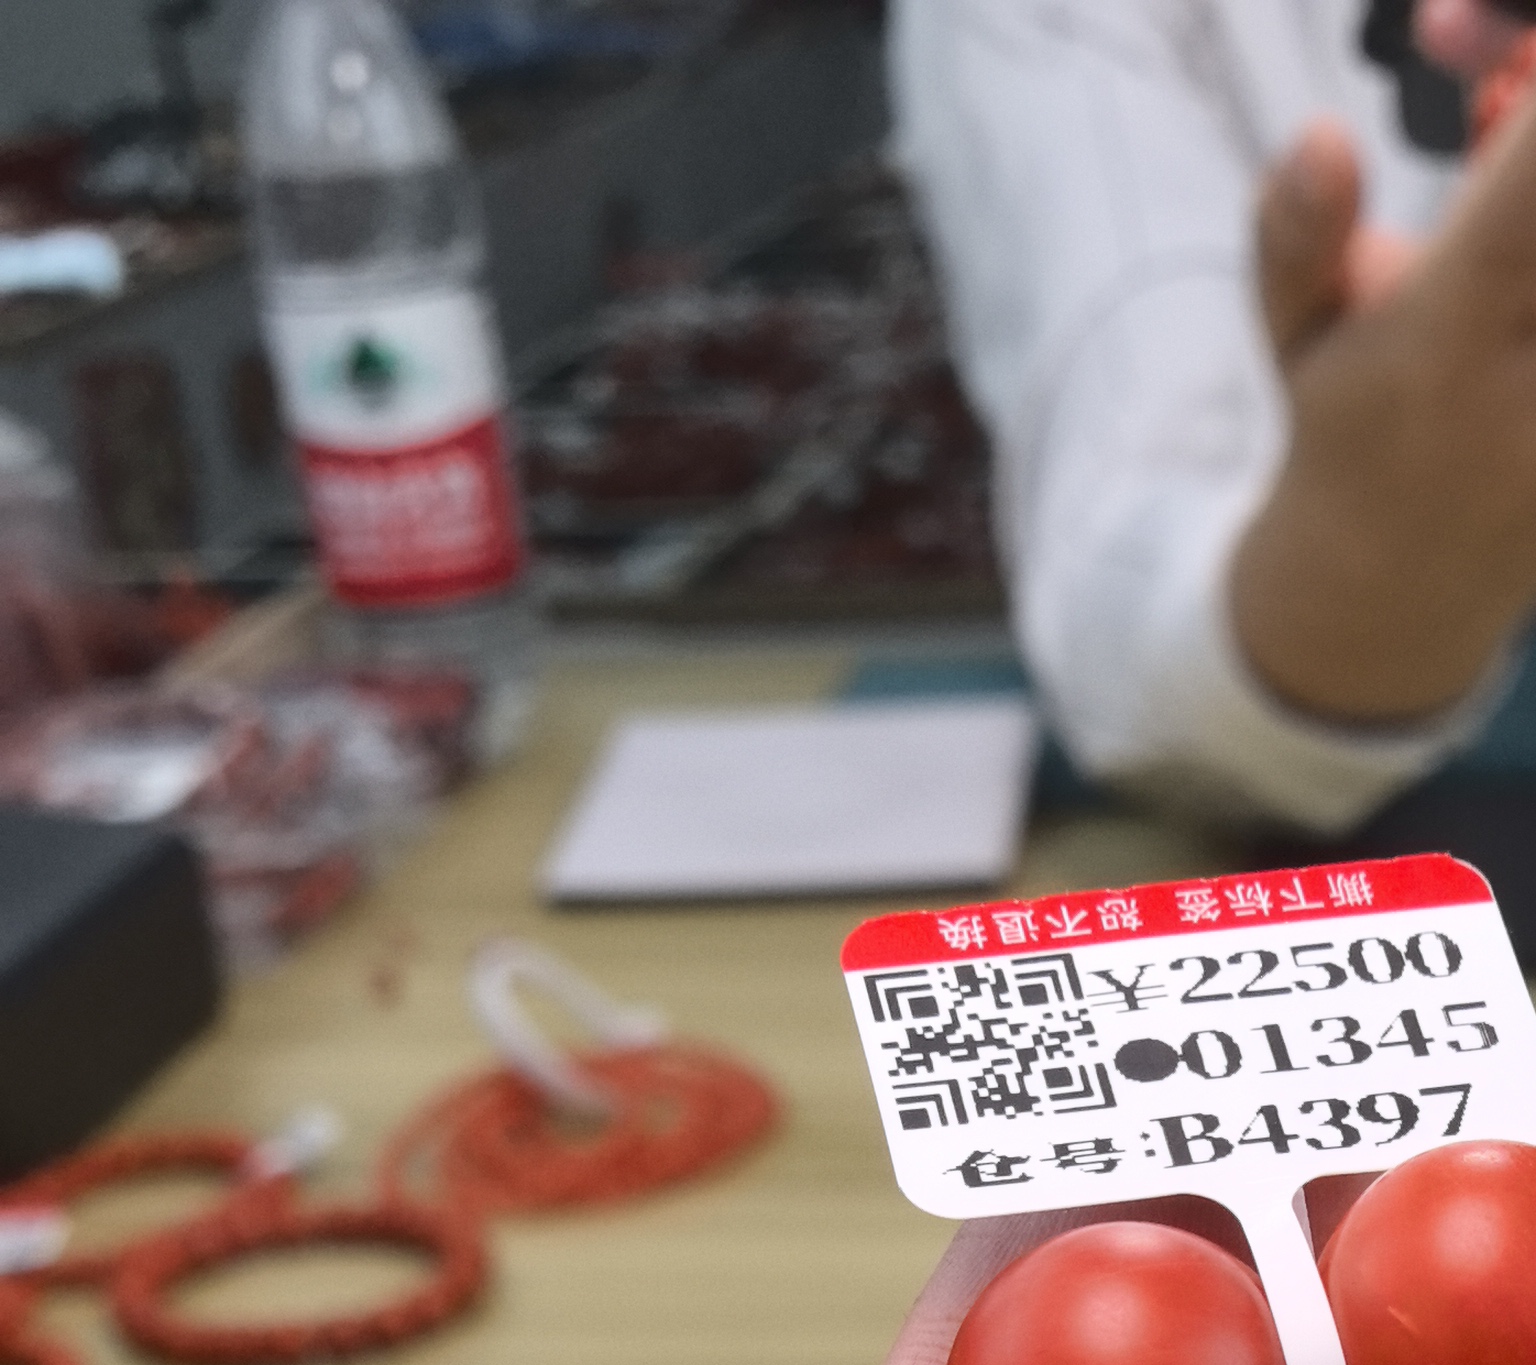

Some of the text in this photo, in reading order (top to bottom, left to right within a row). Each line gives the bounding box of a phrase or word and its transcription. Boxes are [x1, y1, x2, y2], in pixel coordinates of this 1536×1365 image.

[936, 872, 1375, 951] 撕下标签 恕不退换
[1086, 930, 1464, 1013] ¥22500
